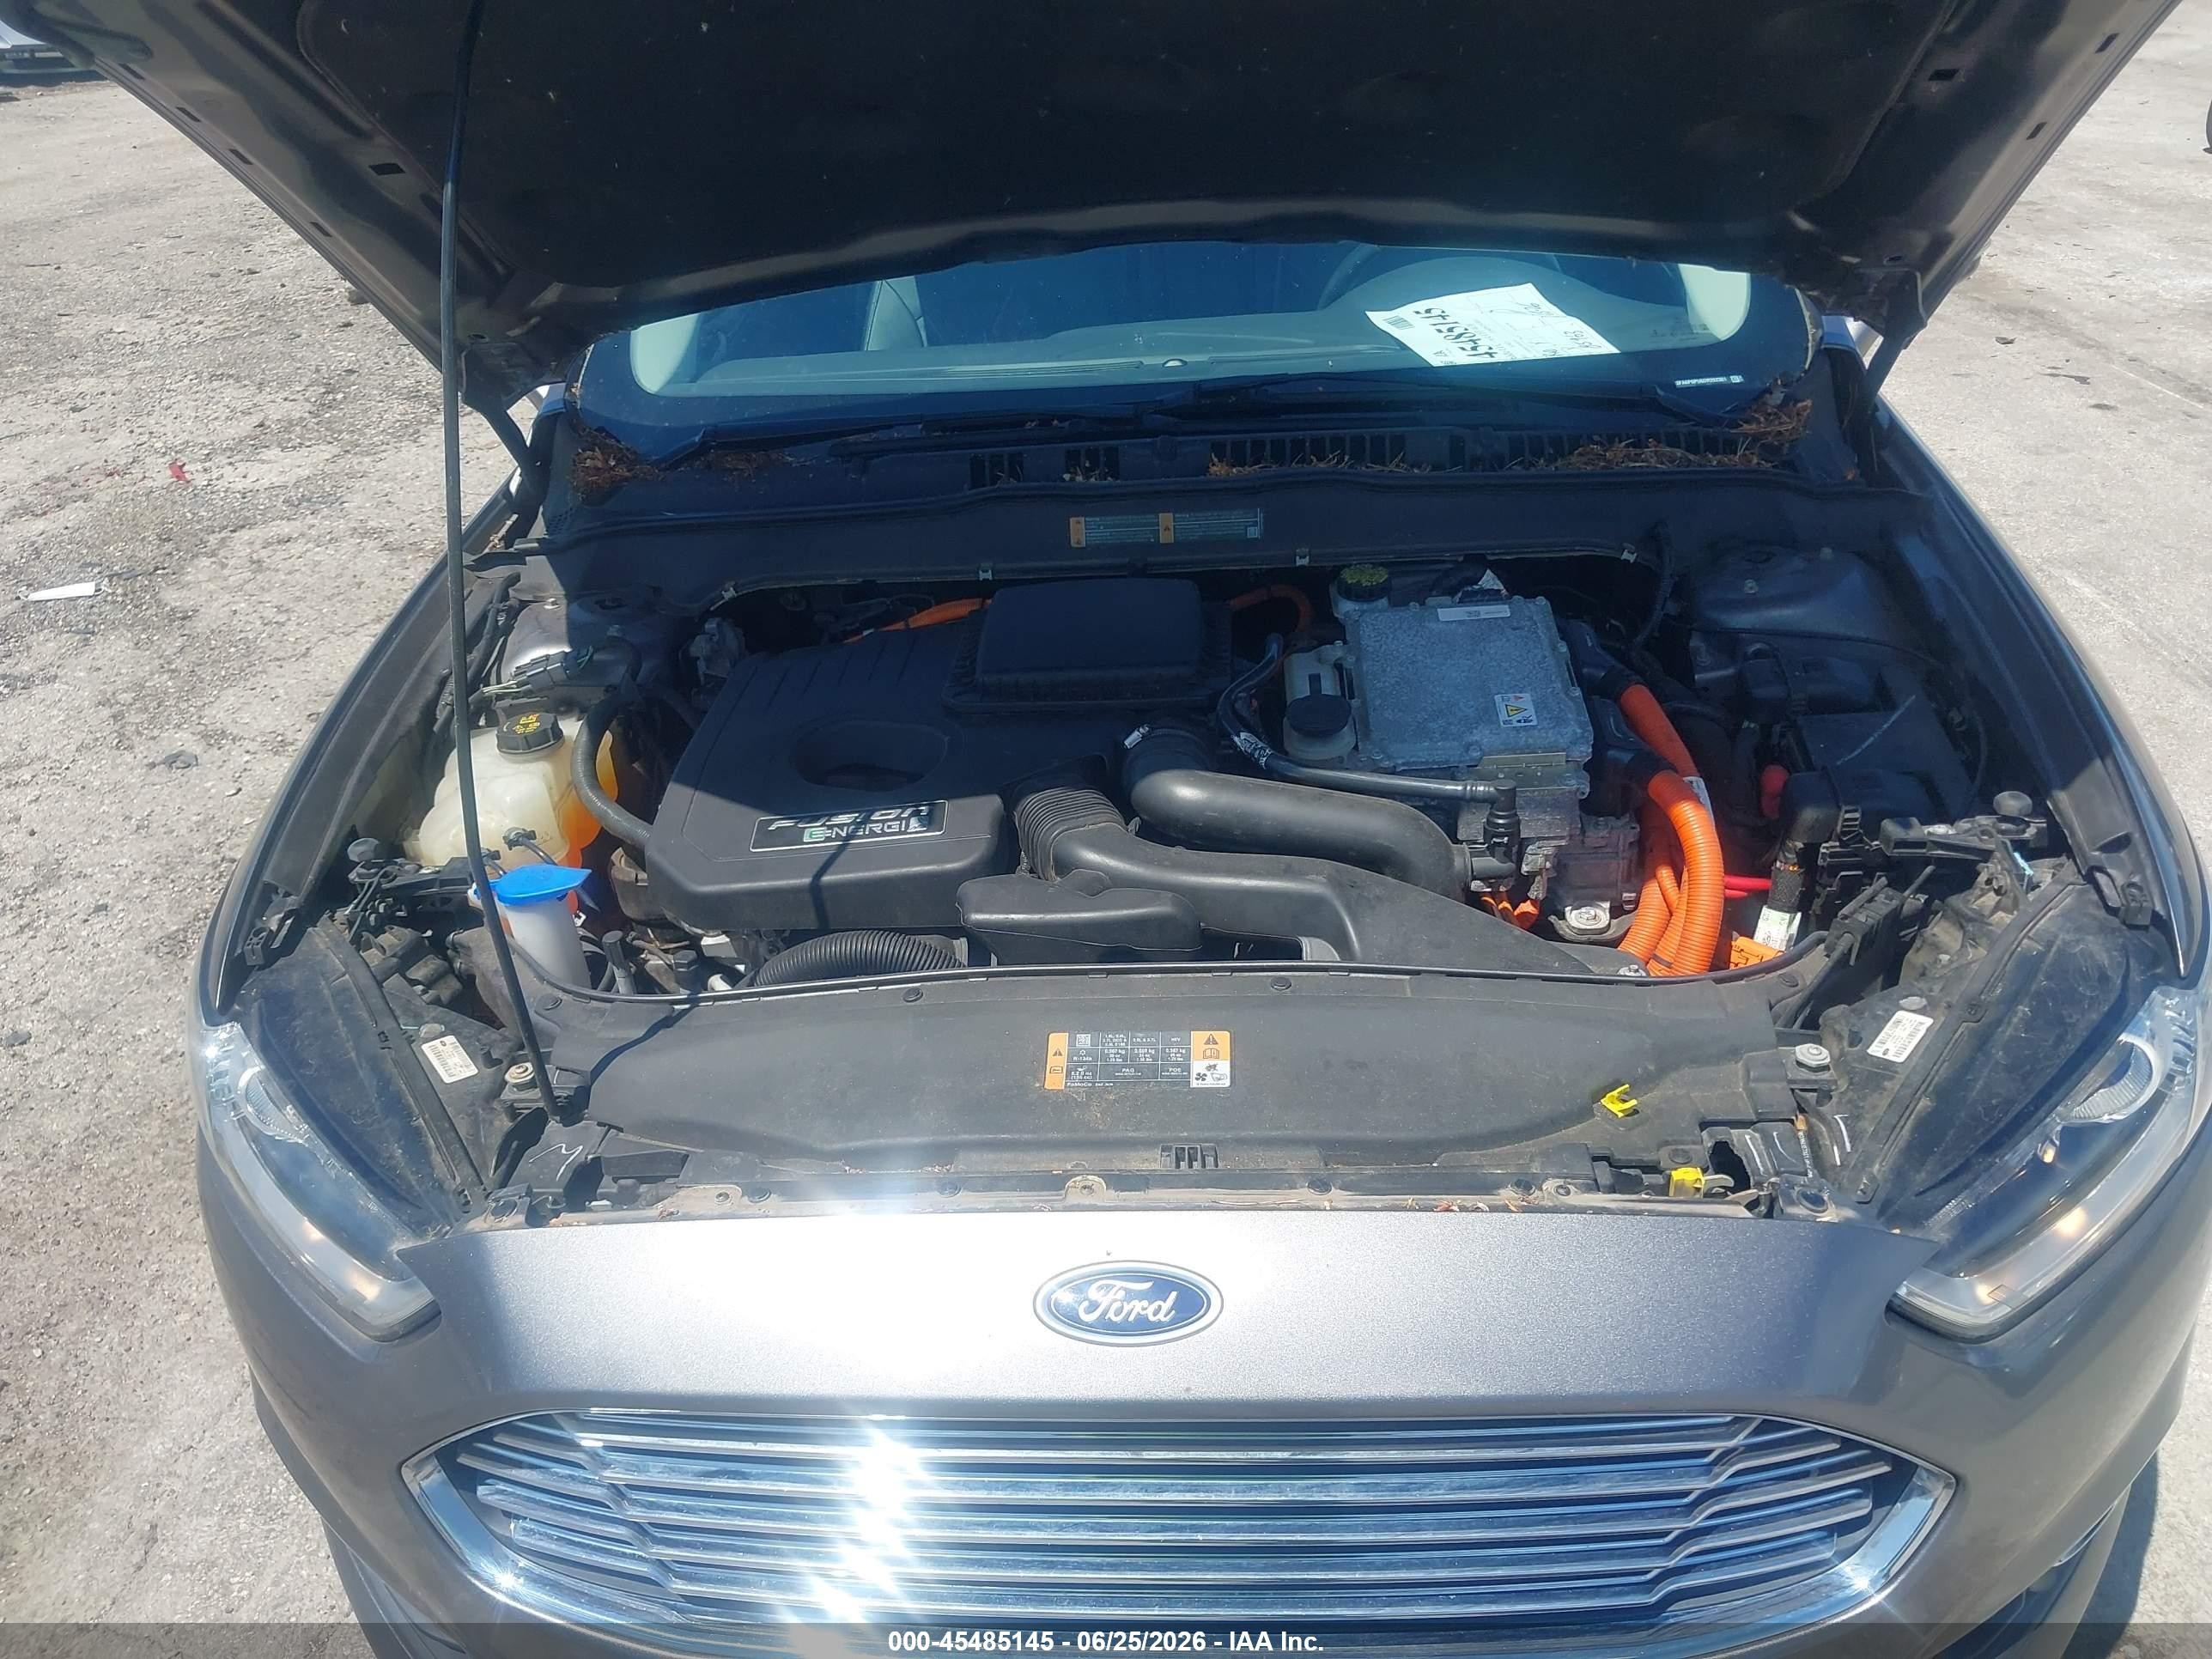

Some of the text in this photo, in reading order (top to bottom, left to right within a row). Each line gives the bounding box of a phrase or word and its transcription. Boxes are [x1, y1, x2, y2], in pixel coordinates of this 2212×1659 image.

[1413, 307, 1499, 359] 45485145
[802, 820, 906, 843] ENERGI
[1079, 1279, 1178, 1323] Ford
